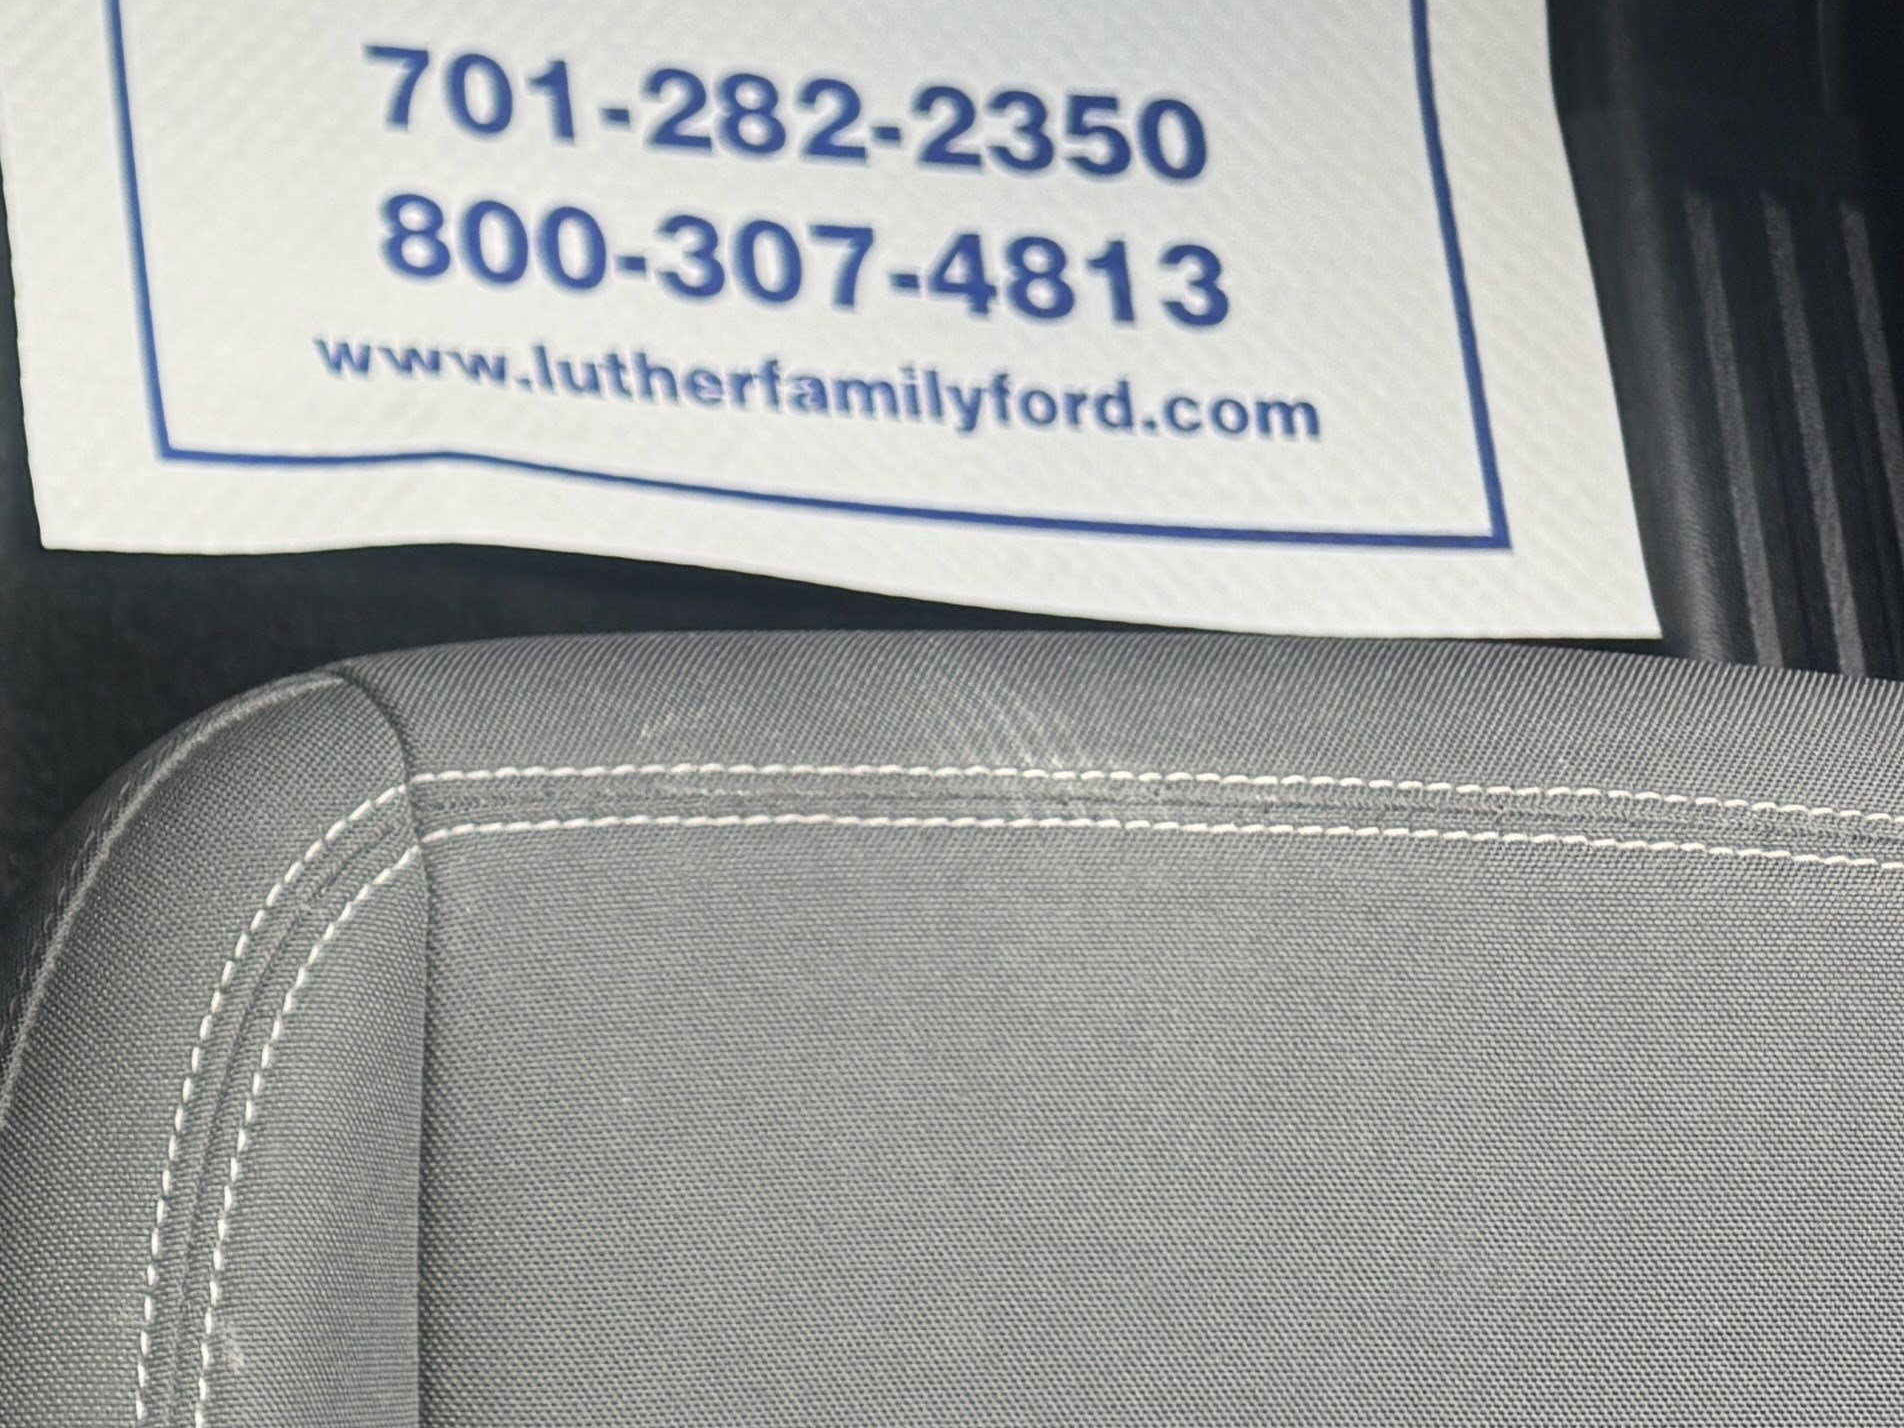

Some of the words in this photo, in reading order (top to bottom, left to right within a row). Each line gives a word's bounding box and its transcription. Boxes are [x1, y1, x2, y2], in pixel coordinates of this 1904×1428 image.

[362, 44, 1209, 180] 701-282-2350
[379, 193, 1231, 330] 800-307-4813
[314, 335, 1322, 440] www.lutherfamilyford.com
